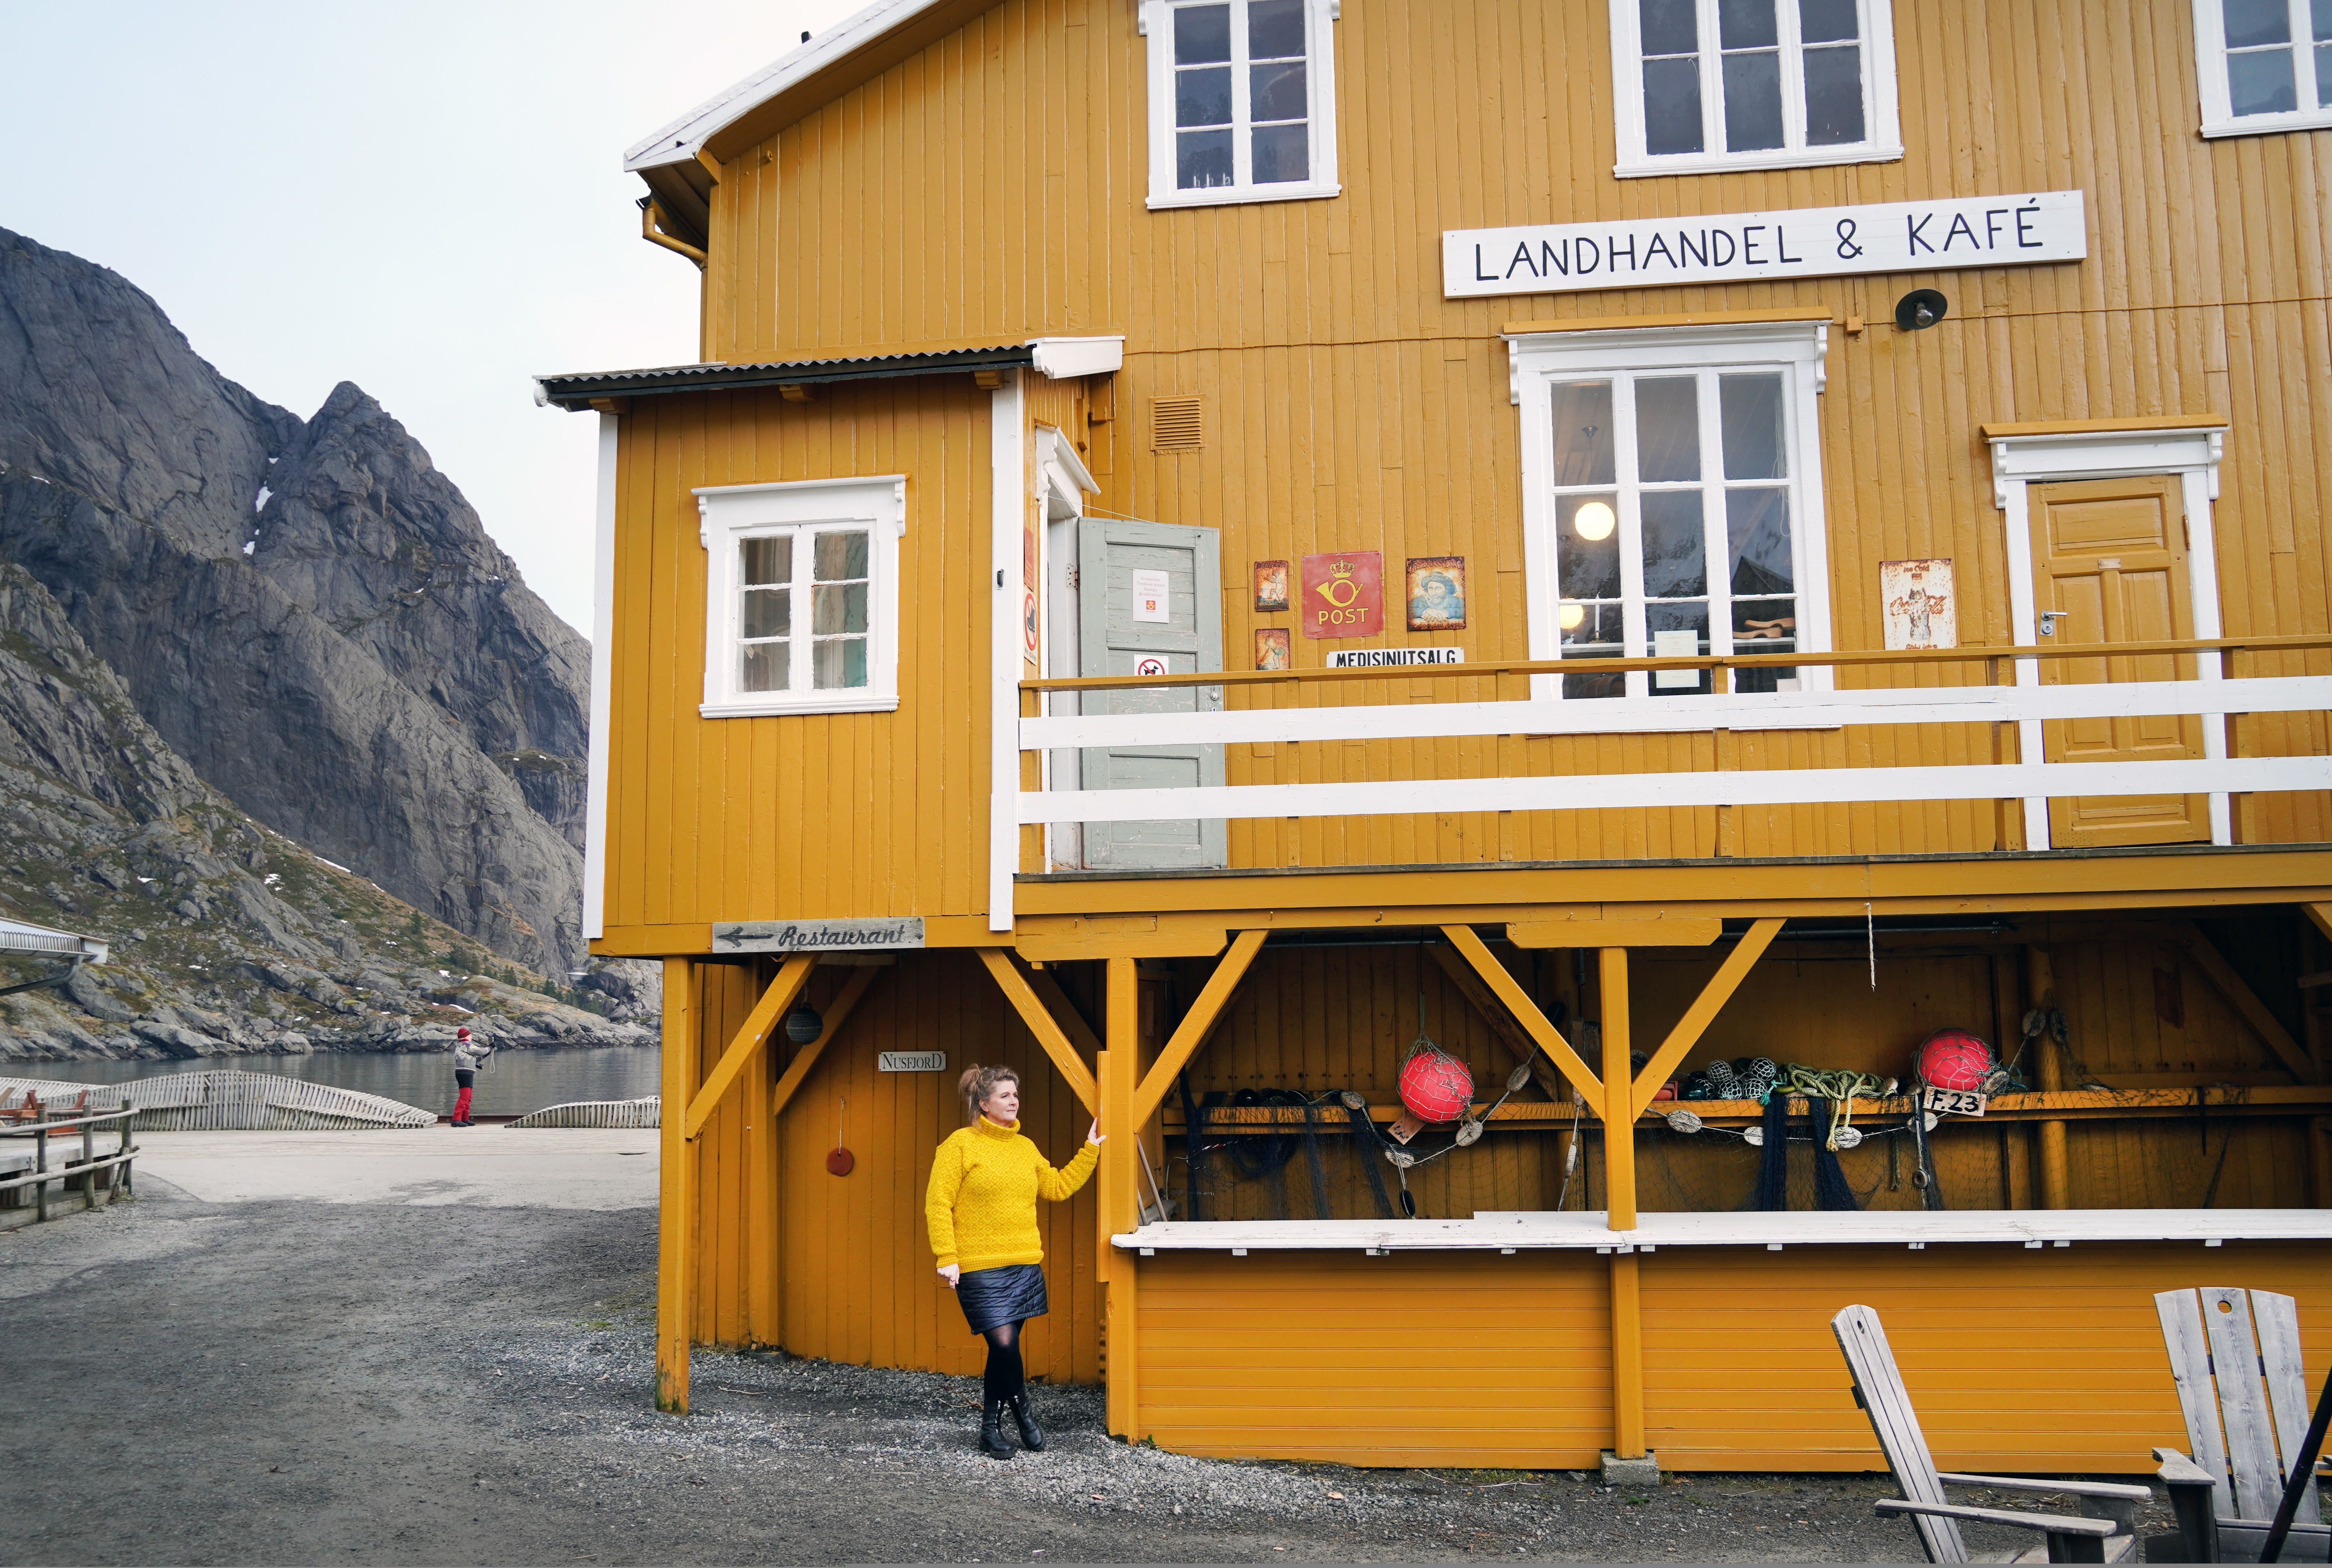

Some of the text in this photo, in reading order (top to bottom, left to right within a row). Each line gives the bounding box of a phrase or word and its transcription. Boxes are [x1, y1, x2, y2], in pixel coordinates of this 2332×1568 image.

[1476, 197, 2043, 281] LANDHANDEL & KAFÉ
[1318, 607, 1369, 625] POST
[1336, 650, 1456, 667] MEDISINUTSALG
[778, 924, 906, 947] Restaurant
[883, 1053, 942, 1069] NUSFJORD
[1931, 1089, 1978, 1112] F.23
